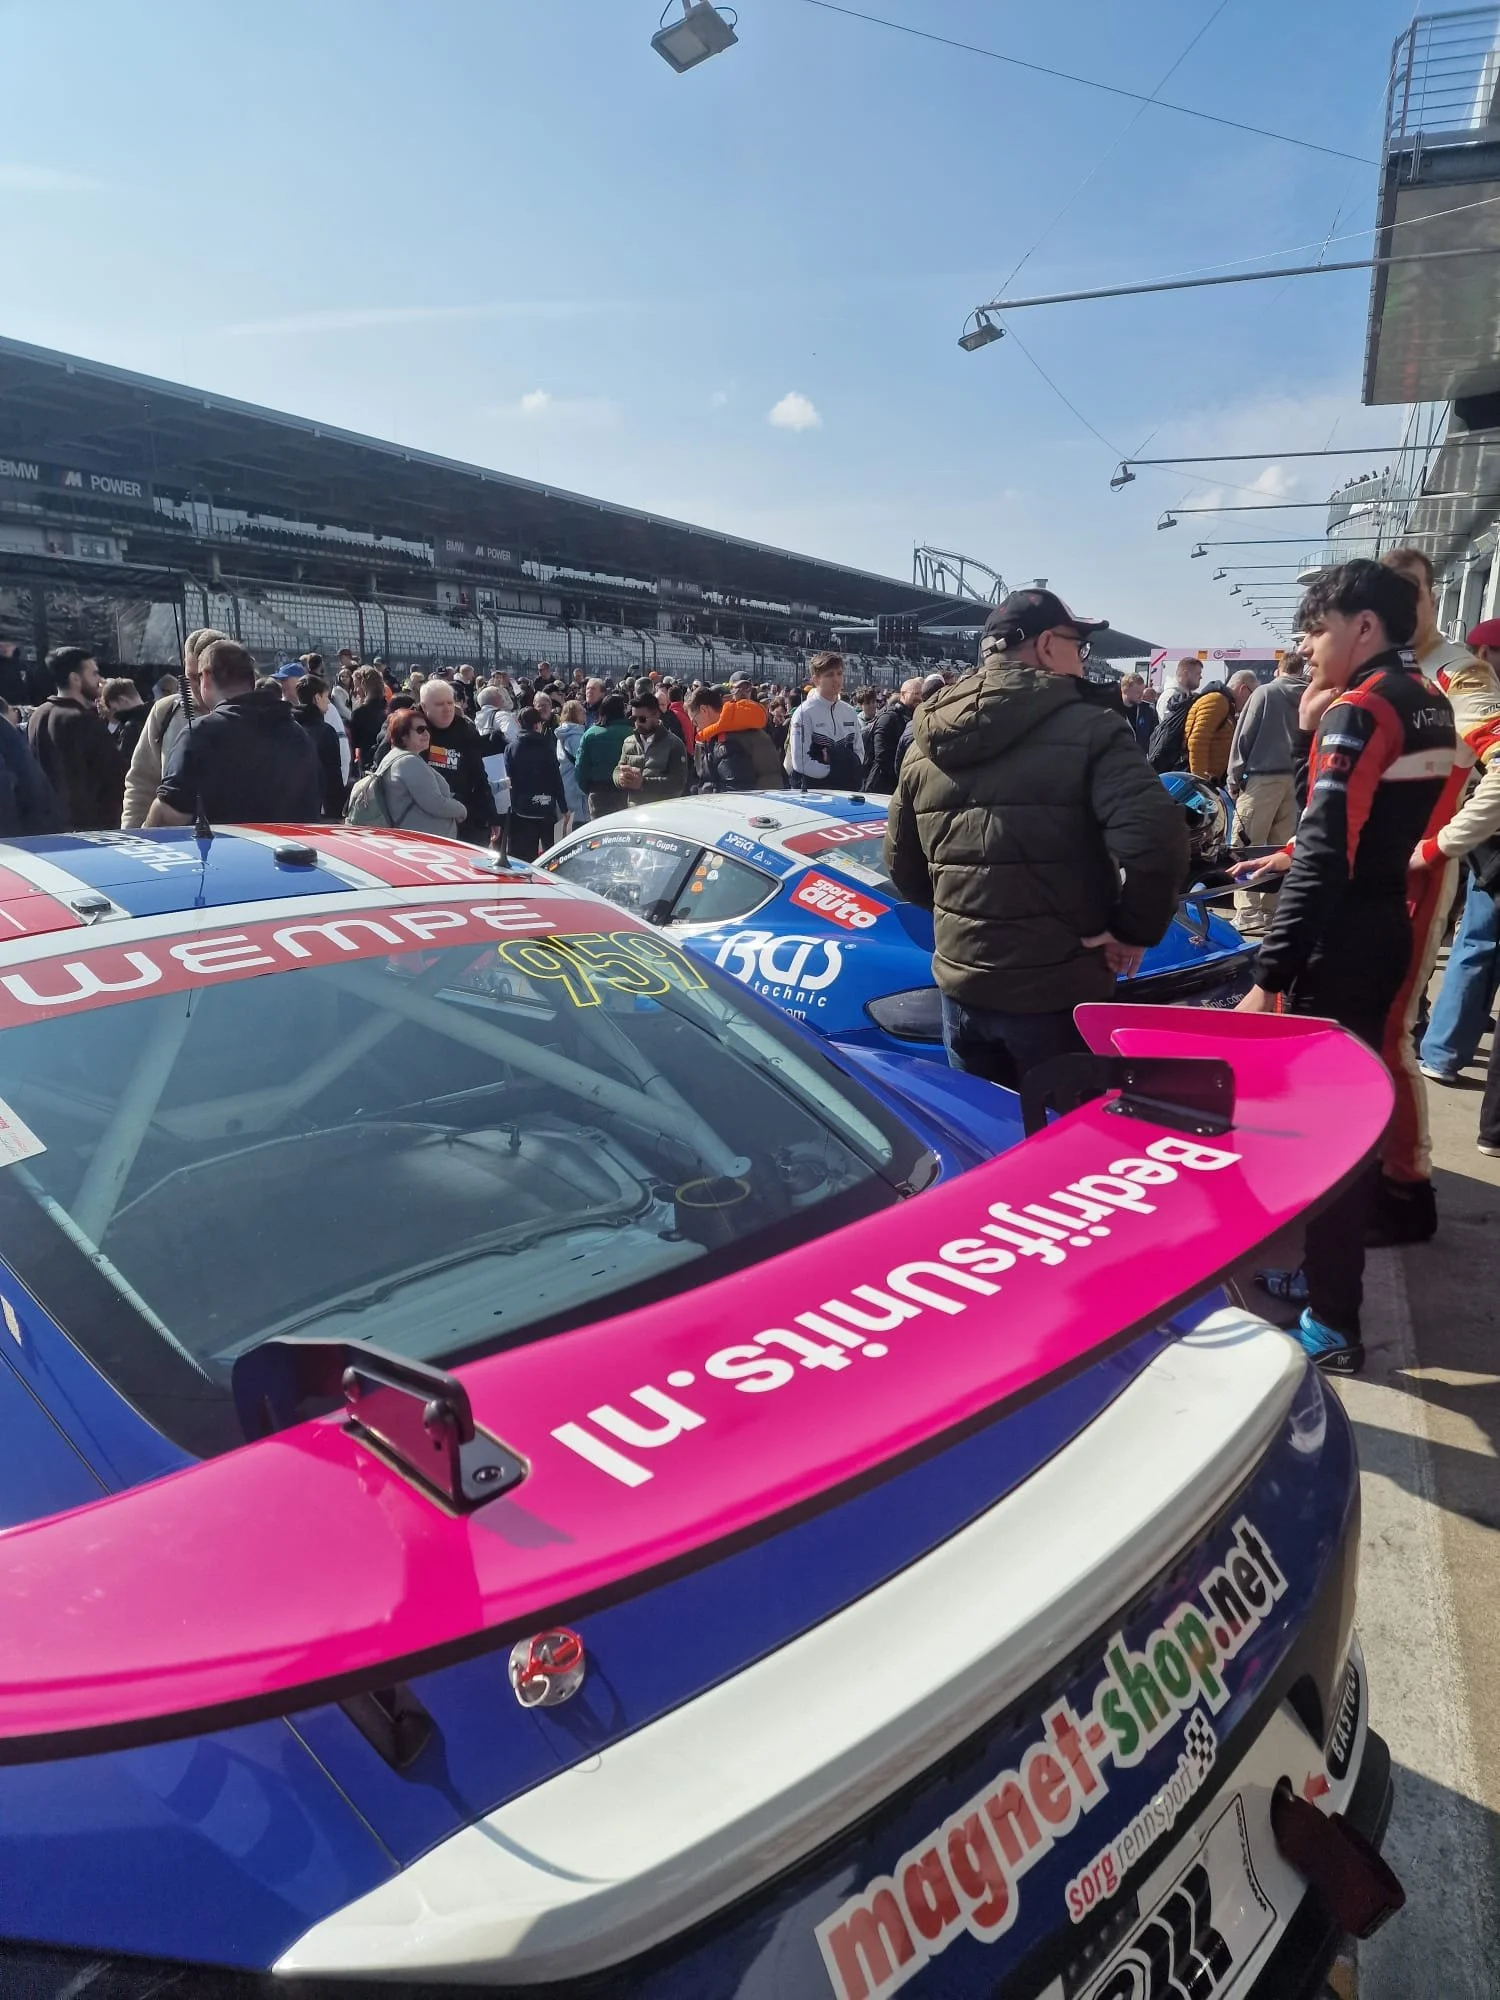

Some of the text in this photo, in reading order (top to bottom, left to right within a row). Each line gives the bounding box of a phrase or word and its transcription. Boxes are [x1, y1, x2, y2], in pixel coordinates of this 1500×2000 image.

[0, 459, 39, 480] BMW
[90, 474, 142, 498] POWER
[446, 540, 464, 553] BMW
[487, 547, 511, 561] POWER
[656, 839, 678, 852] Gupta
[798, 886, 877, 928] auto
[812, 878, 857, 902] sport
[0, 904, 557, 1006] WEMPE
[498, 931, 709, 1008] 959
[715, 930, 842, 990] BGS
[754, 980, 827, 1007] technic
[550, 1136, 1243, 1488] BedrijfsUnits.nl
[824, 1522, 1286, 2000] magnet-shop.net
